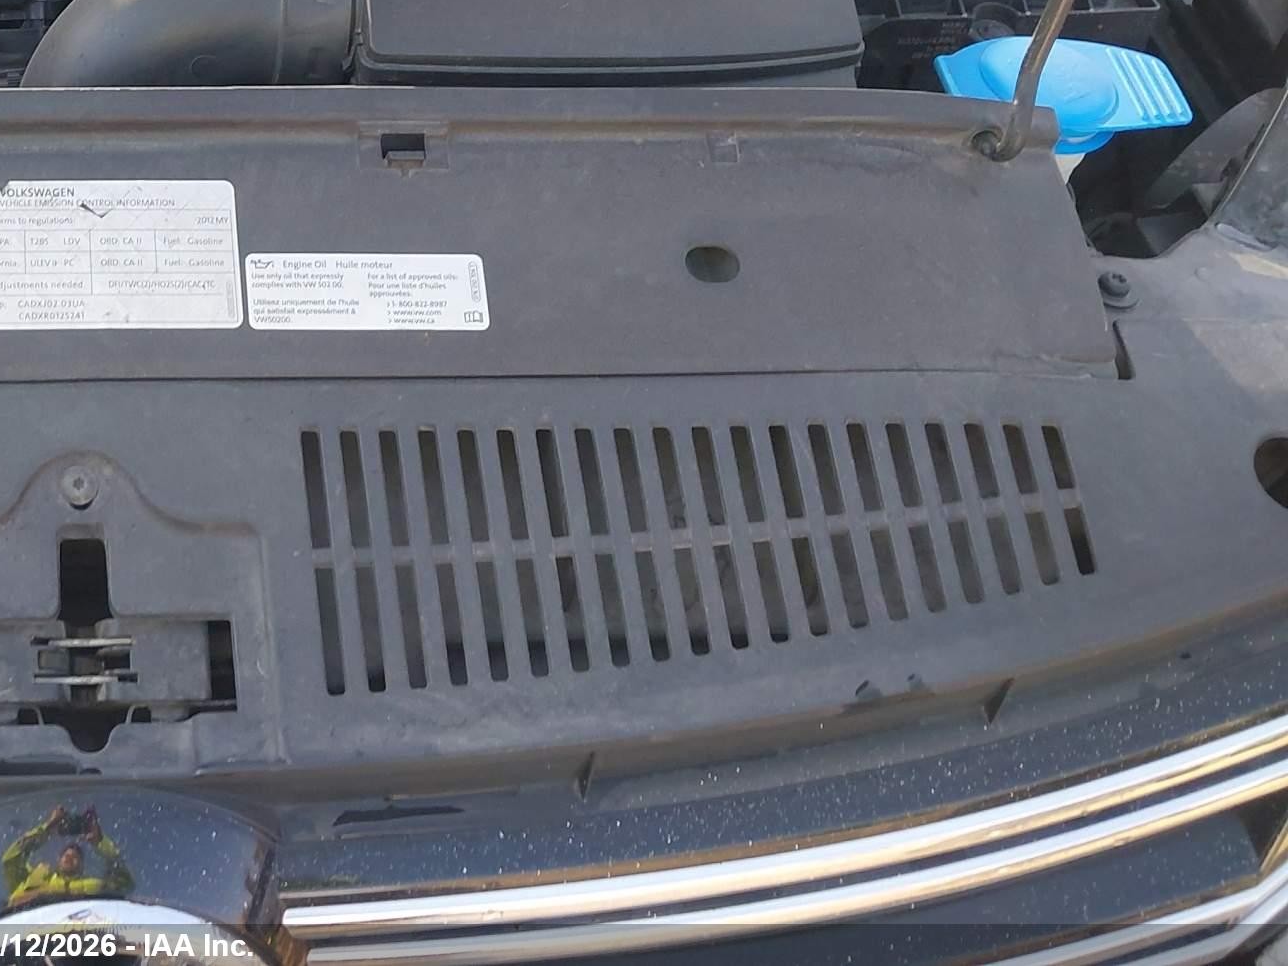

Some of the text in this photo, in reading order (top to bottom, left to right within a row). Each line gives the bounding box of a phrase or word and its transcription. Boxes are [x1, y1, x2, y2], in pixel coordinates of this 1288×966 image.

[0, 186, 75, 197] VOLKSWAGEN
[0, 198, 175, 207] VEHICLE EMISSION CONTROL INFORMATION
[18, 216, 27, 225] to
[63, 237, 81, 245] LDV
[187, 237, 224, 245] Gasoline
[188, 259, 225, 267] Gasoline
[283, 259, 392, 270] Engine Oil Huile moteur
[266, 273, 281, 281] only
[310, 273, 344, 282] expressly
[408, 273, 442, 281] approved
